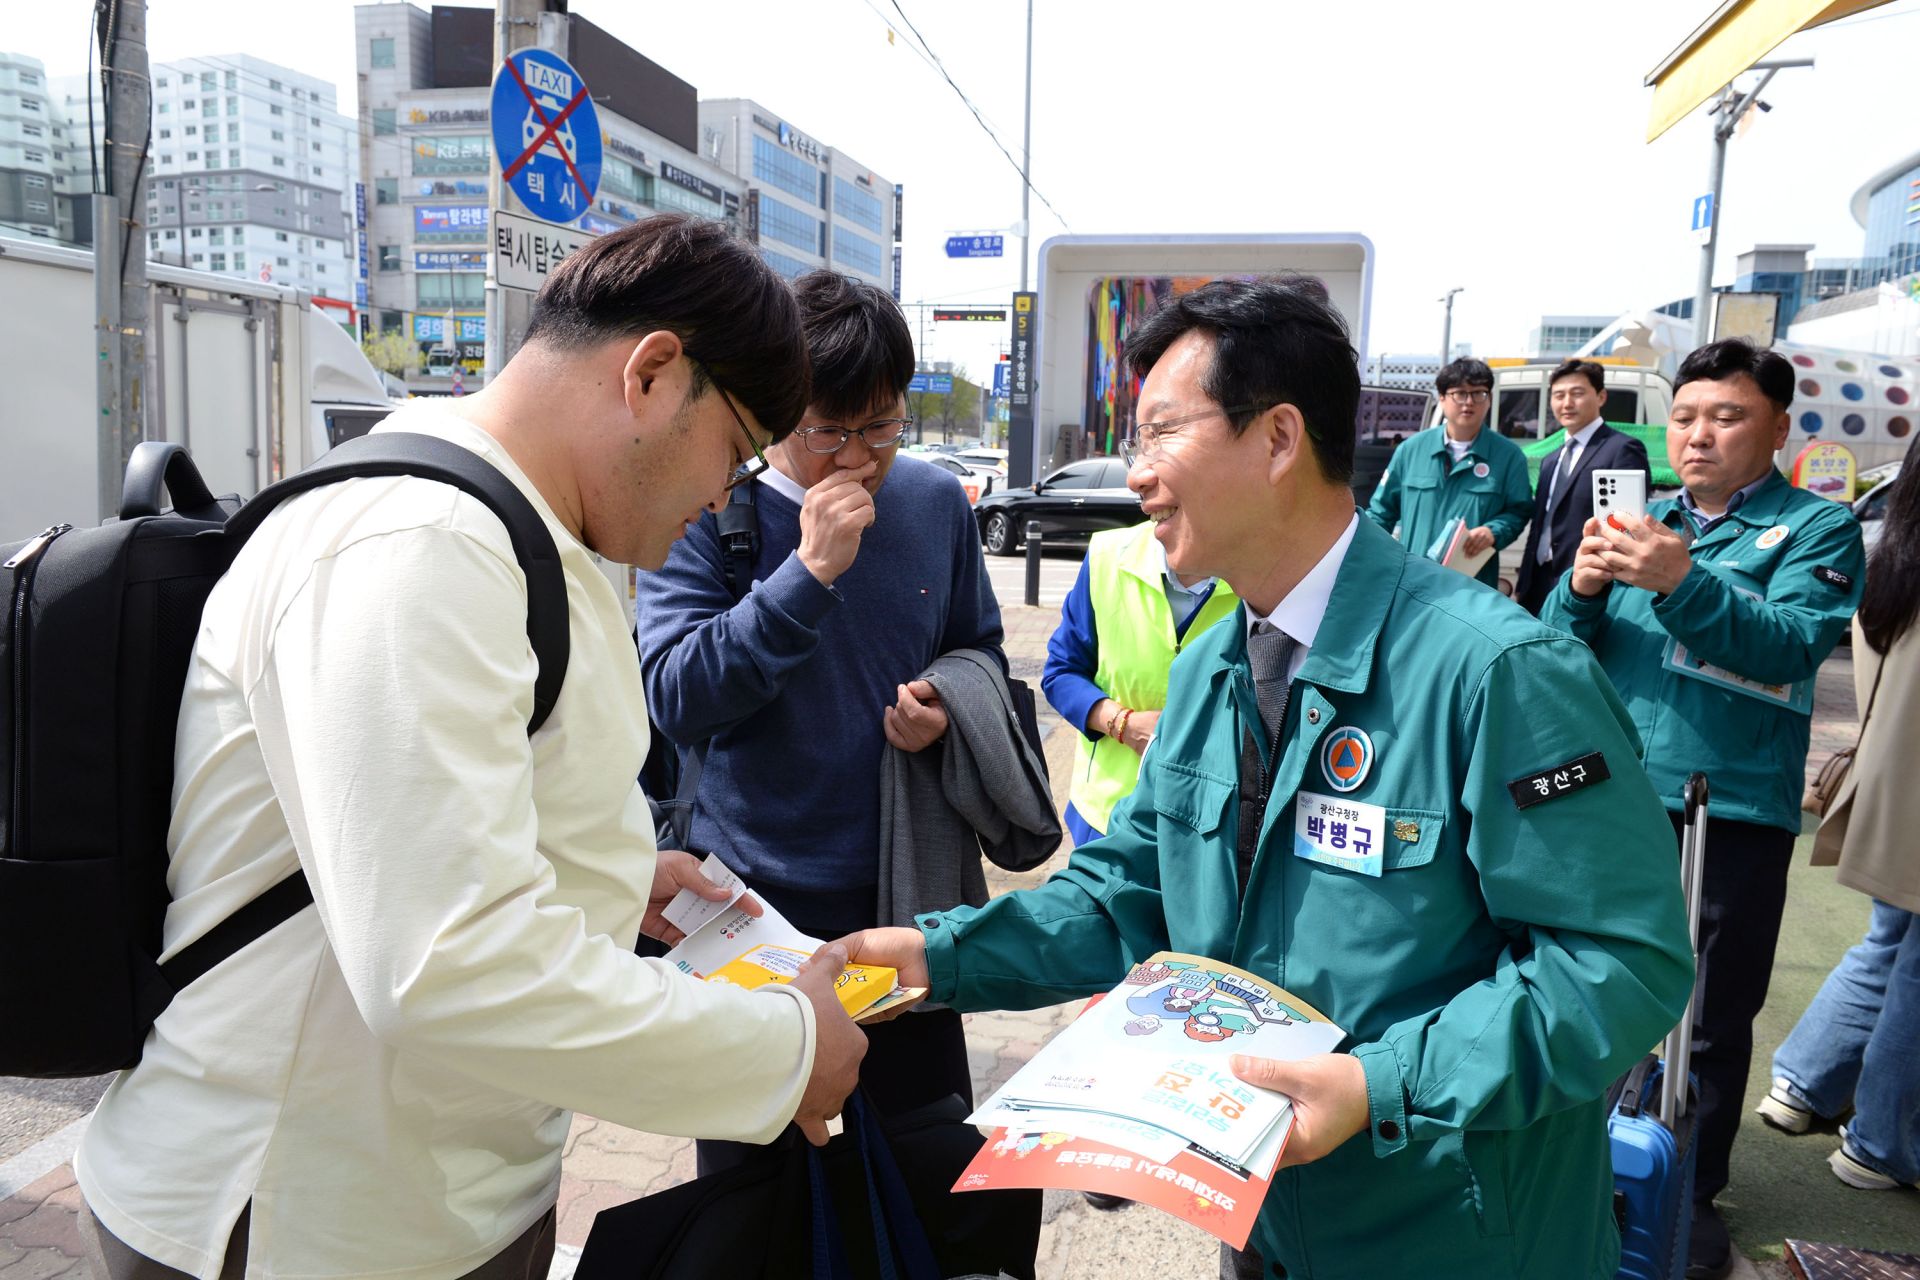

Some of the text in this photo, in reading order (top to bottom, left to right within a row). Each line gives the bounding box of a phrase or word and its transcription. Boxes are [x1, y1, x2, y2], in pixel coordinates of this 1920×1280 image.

[528, 63, 567, 96] TAXI
[498, 226, 579, 274] 택시탑승
[973, 238, 1001, 249] 송정로
[1821, 447, 1837, 456] 2F
[1532, 765, 1587, 796] 광산구
[1320, 803, 1359, 822] 광산구청장
[1307, 815, 1372, 855] 박병규
[1140, 1090, 1231, 1133] 우리집은
[1152, 1071, 1246, 1120] 안전
[1136, 1160, 1237, 1211] 화재발생시
